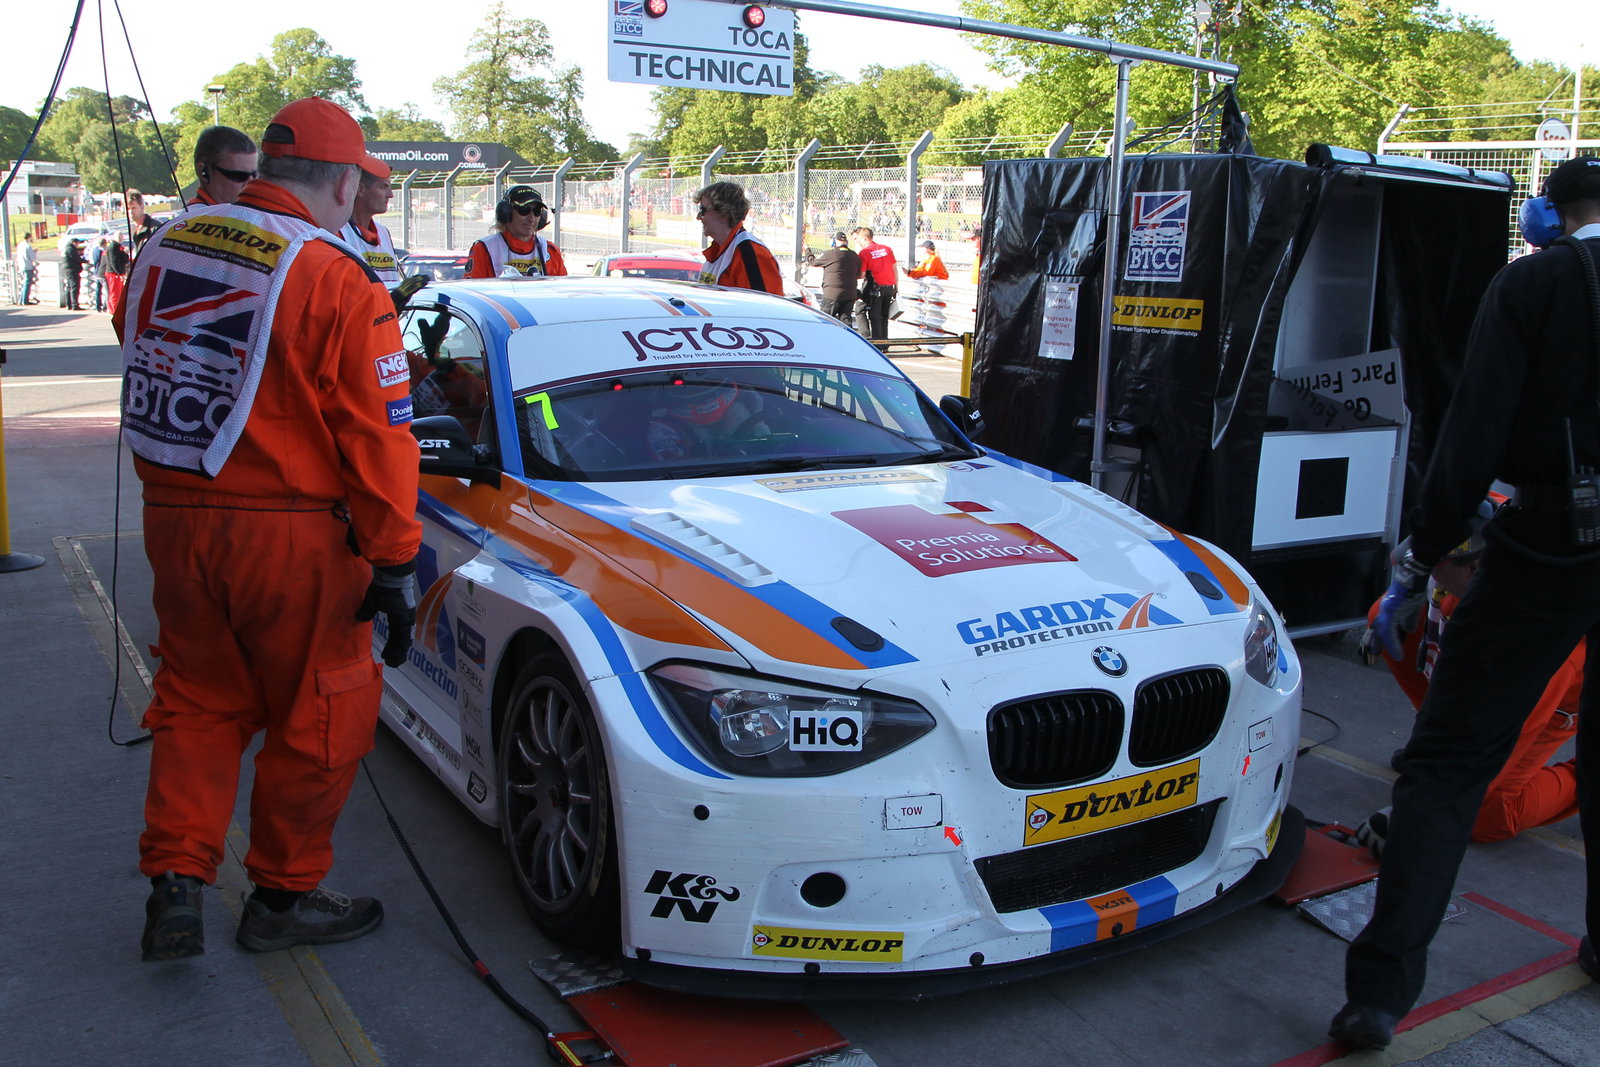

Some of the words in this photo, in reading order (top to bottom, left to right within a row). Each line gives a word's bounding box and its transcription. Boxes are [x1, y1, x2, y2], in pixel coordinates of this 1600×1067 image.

[615, 22, 642, 34] BTCC
[728, 26, 790, 50] TOCA
[629, 51, 790, 89] TECHNICAL
[186, 222, 282, 254] DUNLOP
[1129, 247, 1182, 270] BTCC
[373, 312, 396, 327] AWS
[1121, 304, 1202, 320] DUNLOP
[621, 322, 795, 362] JCT600
[1160, 329, 1198, 337] Championship
[652, 353, 682, 361] Trusted
[683, 352, 694, 360] by
[1351, 361, 1397, 385] Parc
[524, 391, 560, 430] 7
[165, 431, 182, 440] CAR
[793, 471, 918, 485] DUNLOP
[896, 531, 1001, 551] Premia
[917, 542, 1055, 567] Solutions
[956, 597, 1117, 645] GARDX
[974, 620, 1114, 657] PROTECTION
[793, 716, 860, 747] HiQ
[1255, 730, 1266, 740] TOW
[1058, 772, 1198, 825] DUNLOP
[900, 806, 923, 817] TOW
[776, 935, 904, 953] DUNLOP
